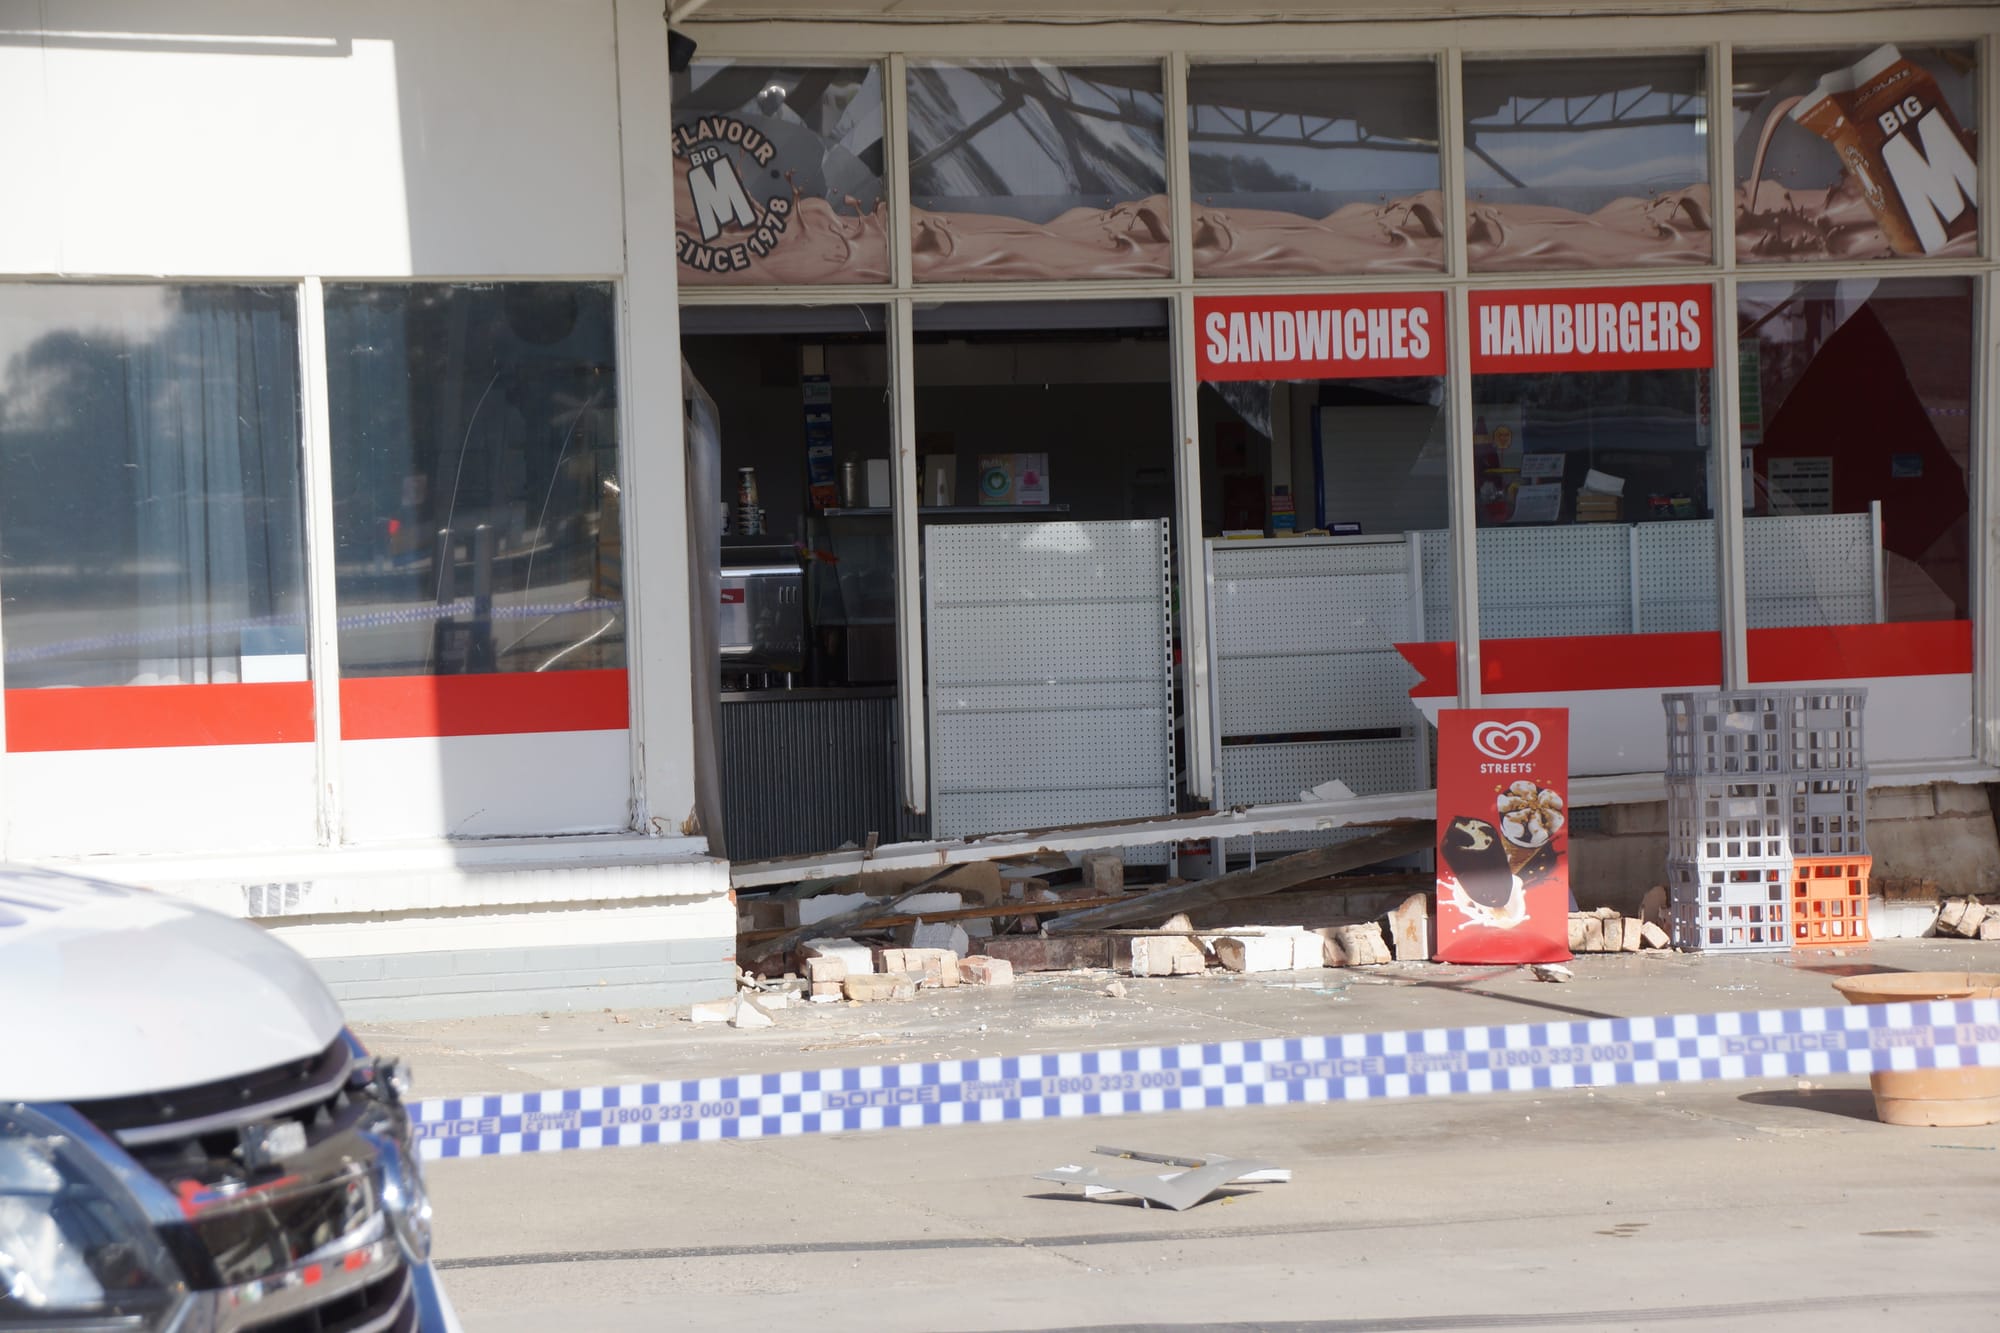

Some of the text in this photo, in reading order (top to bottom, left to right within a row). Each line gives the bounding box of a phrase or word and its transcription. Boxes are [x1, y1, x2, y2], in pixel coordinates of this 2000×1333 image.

[1878, 95, 1923, 137] BIG
[690, 147, 719, 166] BIG
[1882, 107, 1977, 255] M
[688, 157, 756, 241] M
[749, 198, 789, 256] 1978
[1205, 306, 1431, 364] SANDWICHES
[1479, 299, 1702, 356] HAMBURGERS
[1480, 762, 1533, 774] STREETS
